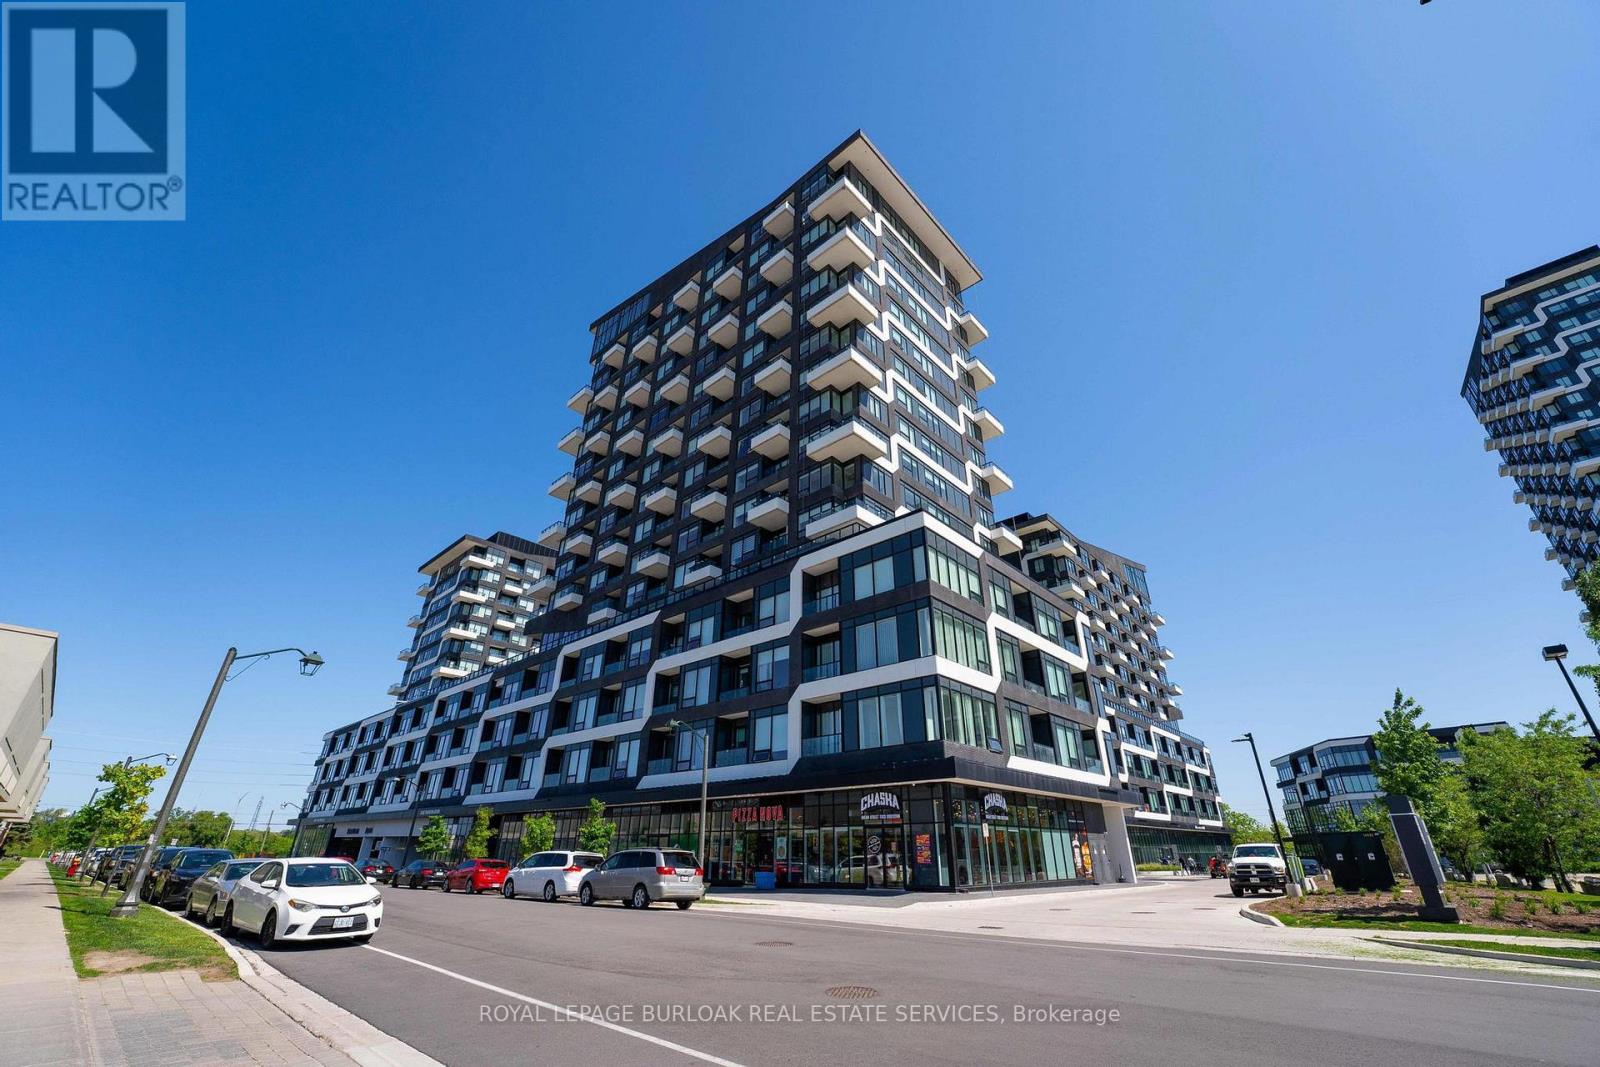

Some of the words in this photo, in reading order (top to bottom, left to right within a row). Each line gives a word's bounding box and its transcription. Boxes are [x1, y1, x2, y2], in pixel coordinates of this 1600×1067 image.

[861, 792, 900, 812] CHASHA
[984, 793, 1008, 812] CHASHA
[732, 807, 757, 822] PIZZA
[760, 805, 783, 821] NOVA
